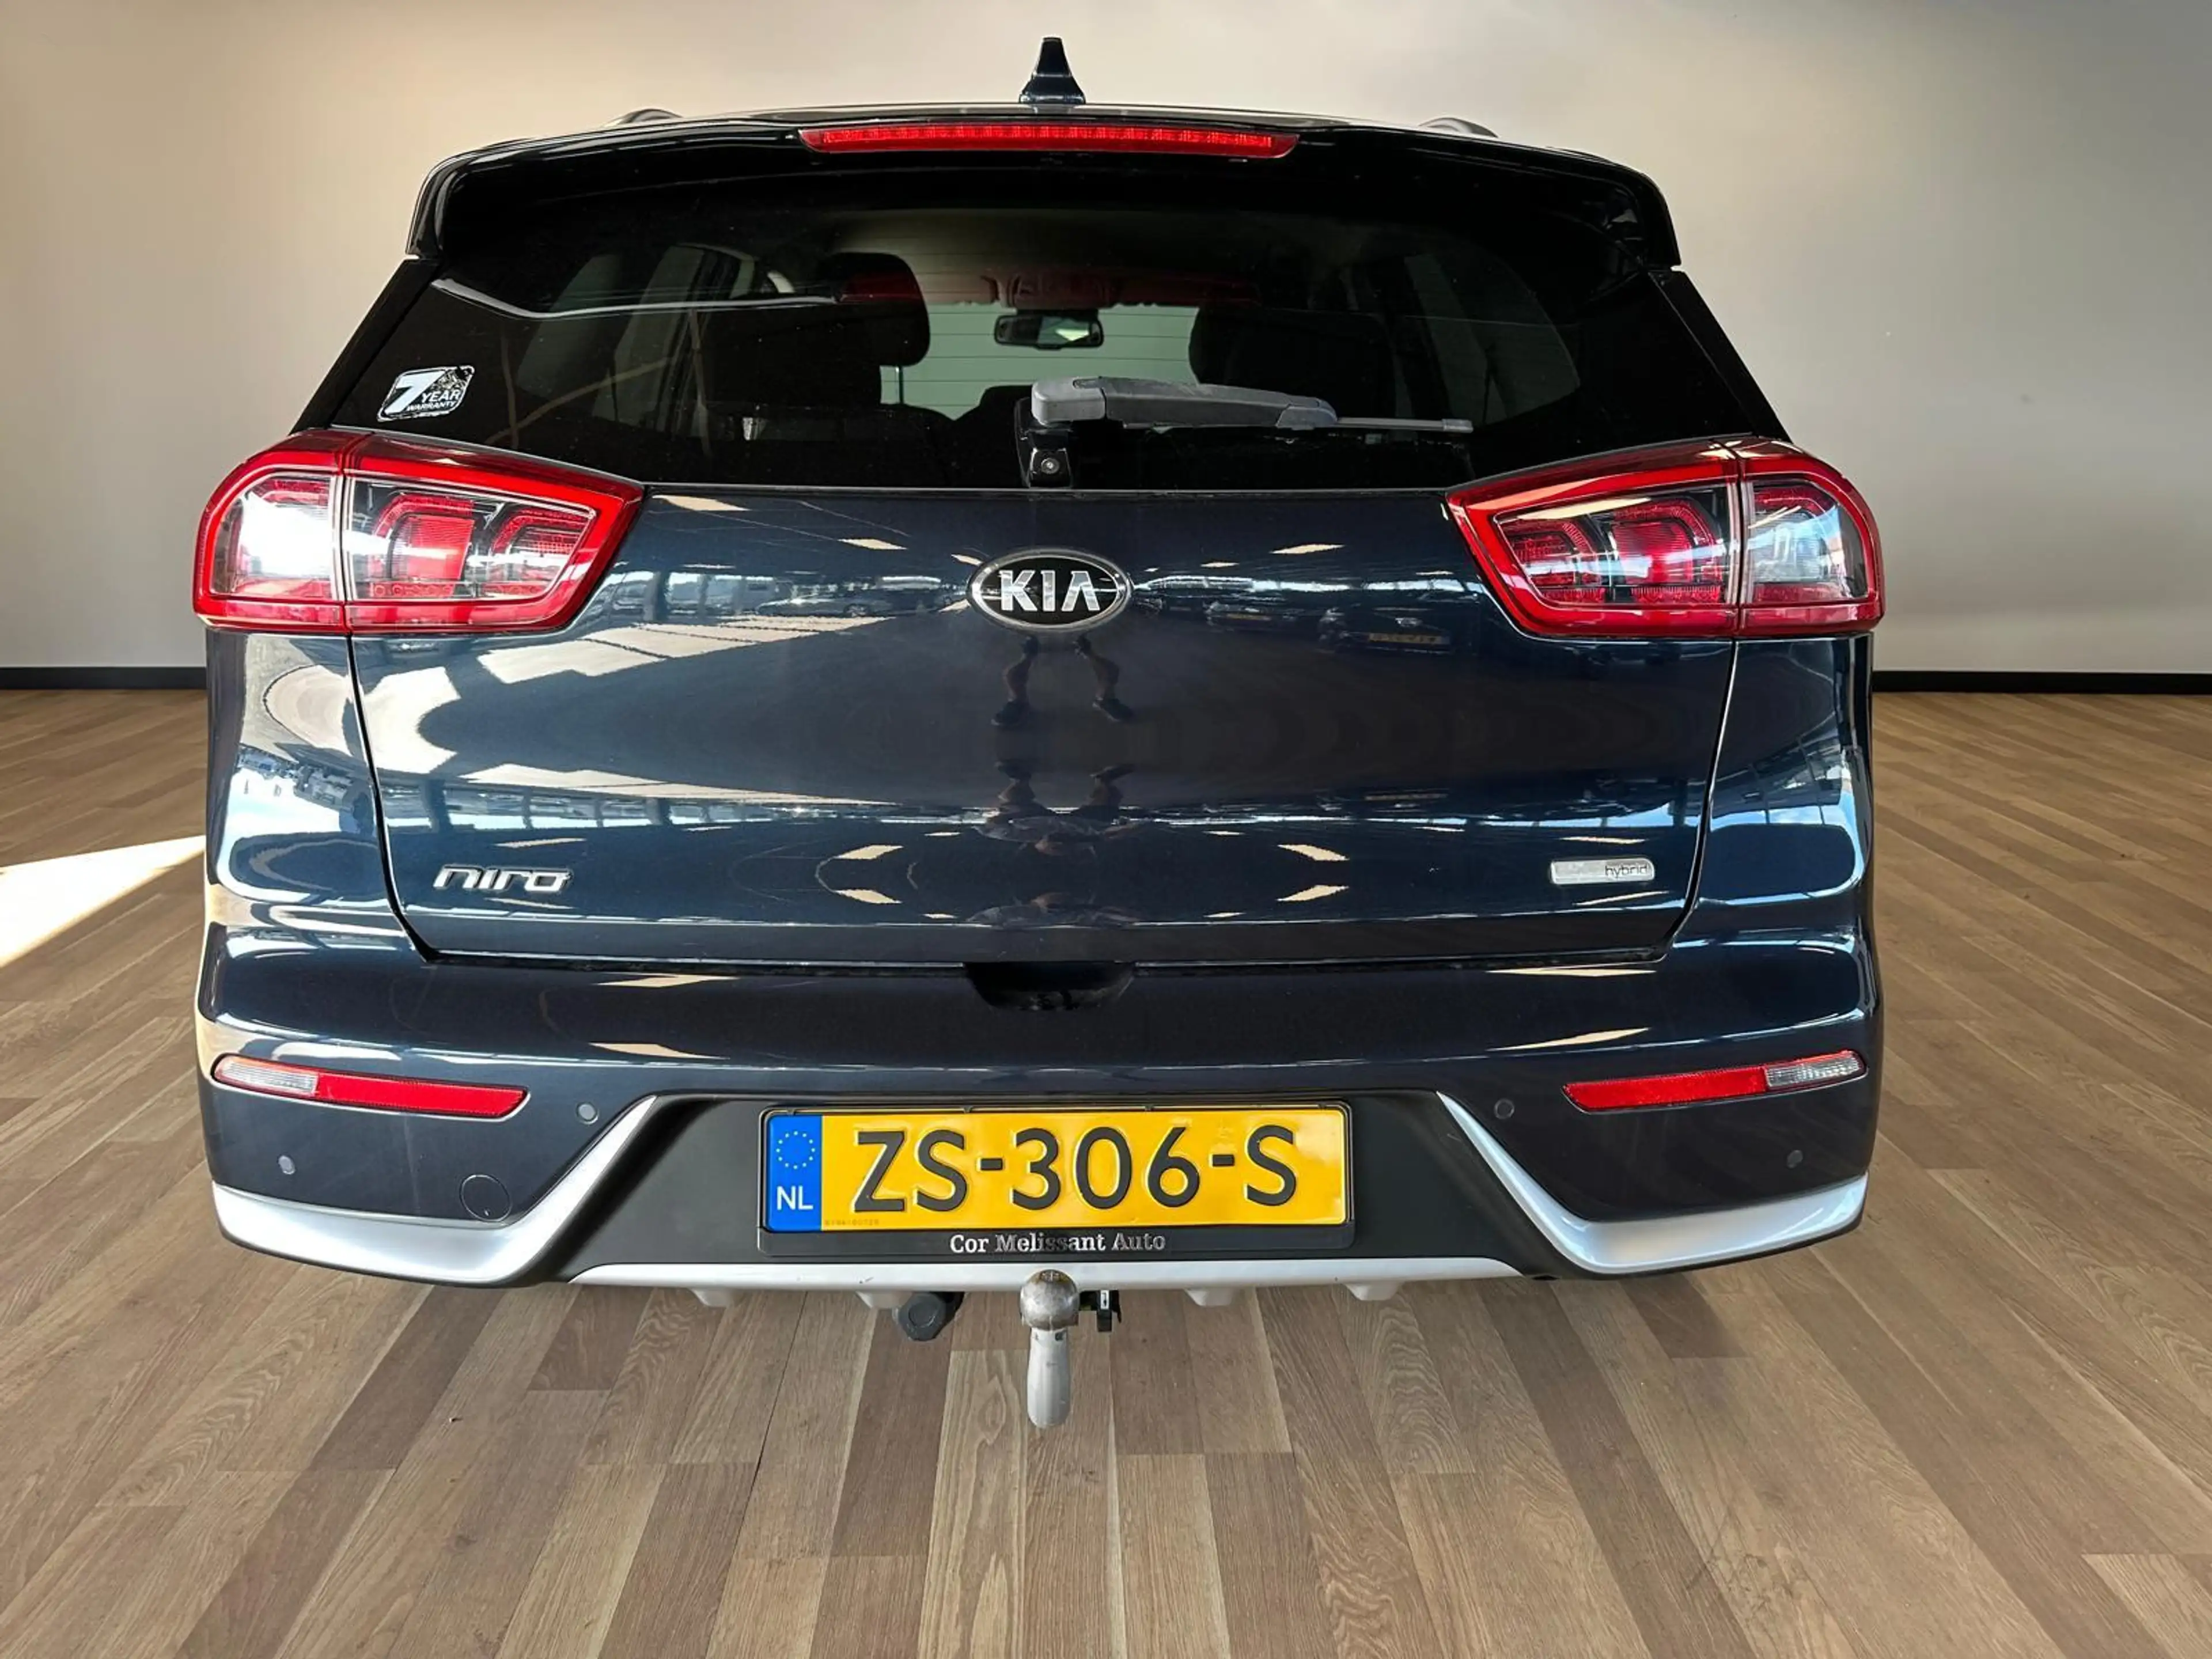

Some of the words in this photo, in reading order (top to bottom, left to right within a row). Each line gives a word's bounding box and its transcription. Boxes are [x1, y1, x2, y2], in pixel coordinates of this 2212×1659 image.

[383, 371, 445, 415] 7
[999, 570, 1100, 612] KIA
[433, 865, 570, 892] niro
[1605, 865, 1647, 878] hybrid
[853, 1124, 1297, 1213] ZS-306-S
[777, 1185, 813, 1210] NL
[949, 1234, 989, 1253] Cor
[995, 1232, 1106, 1252] Melissant
[1111, 1232, 1166, 1251] Auto
